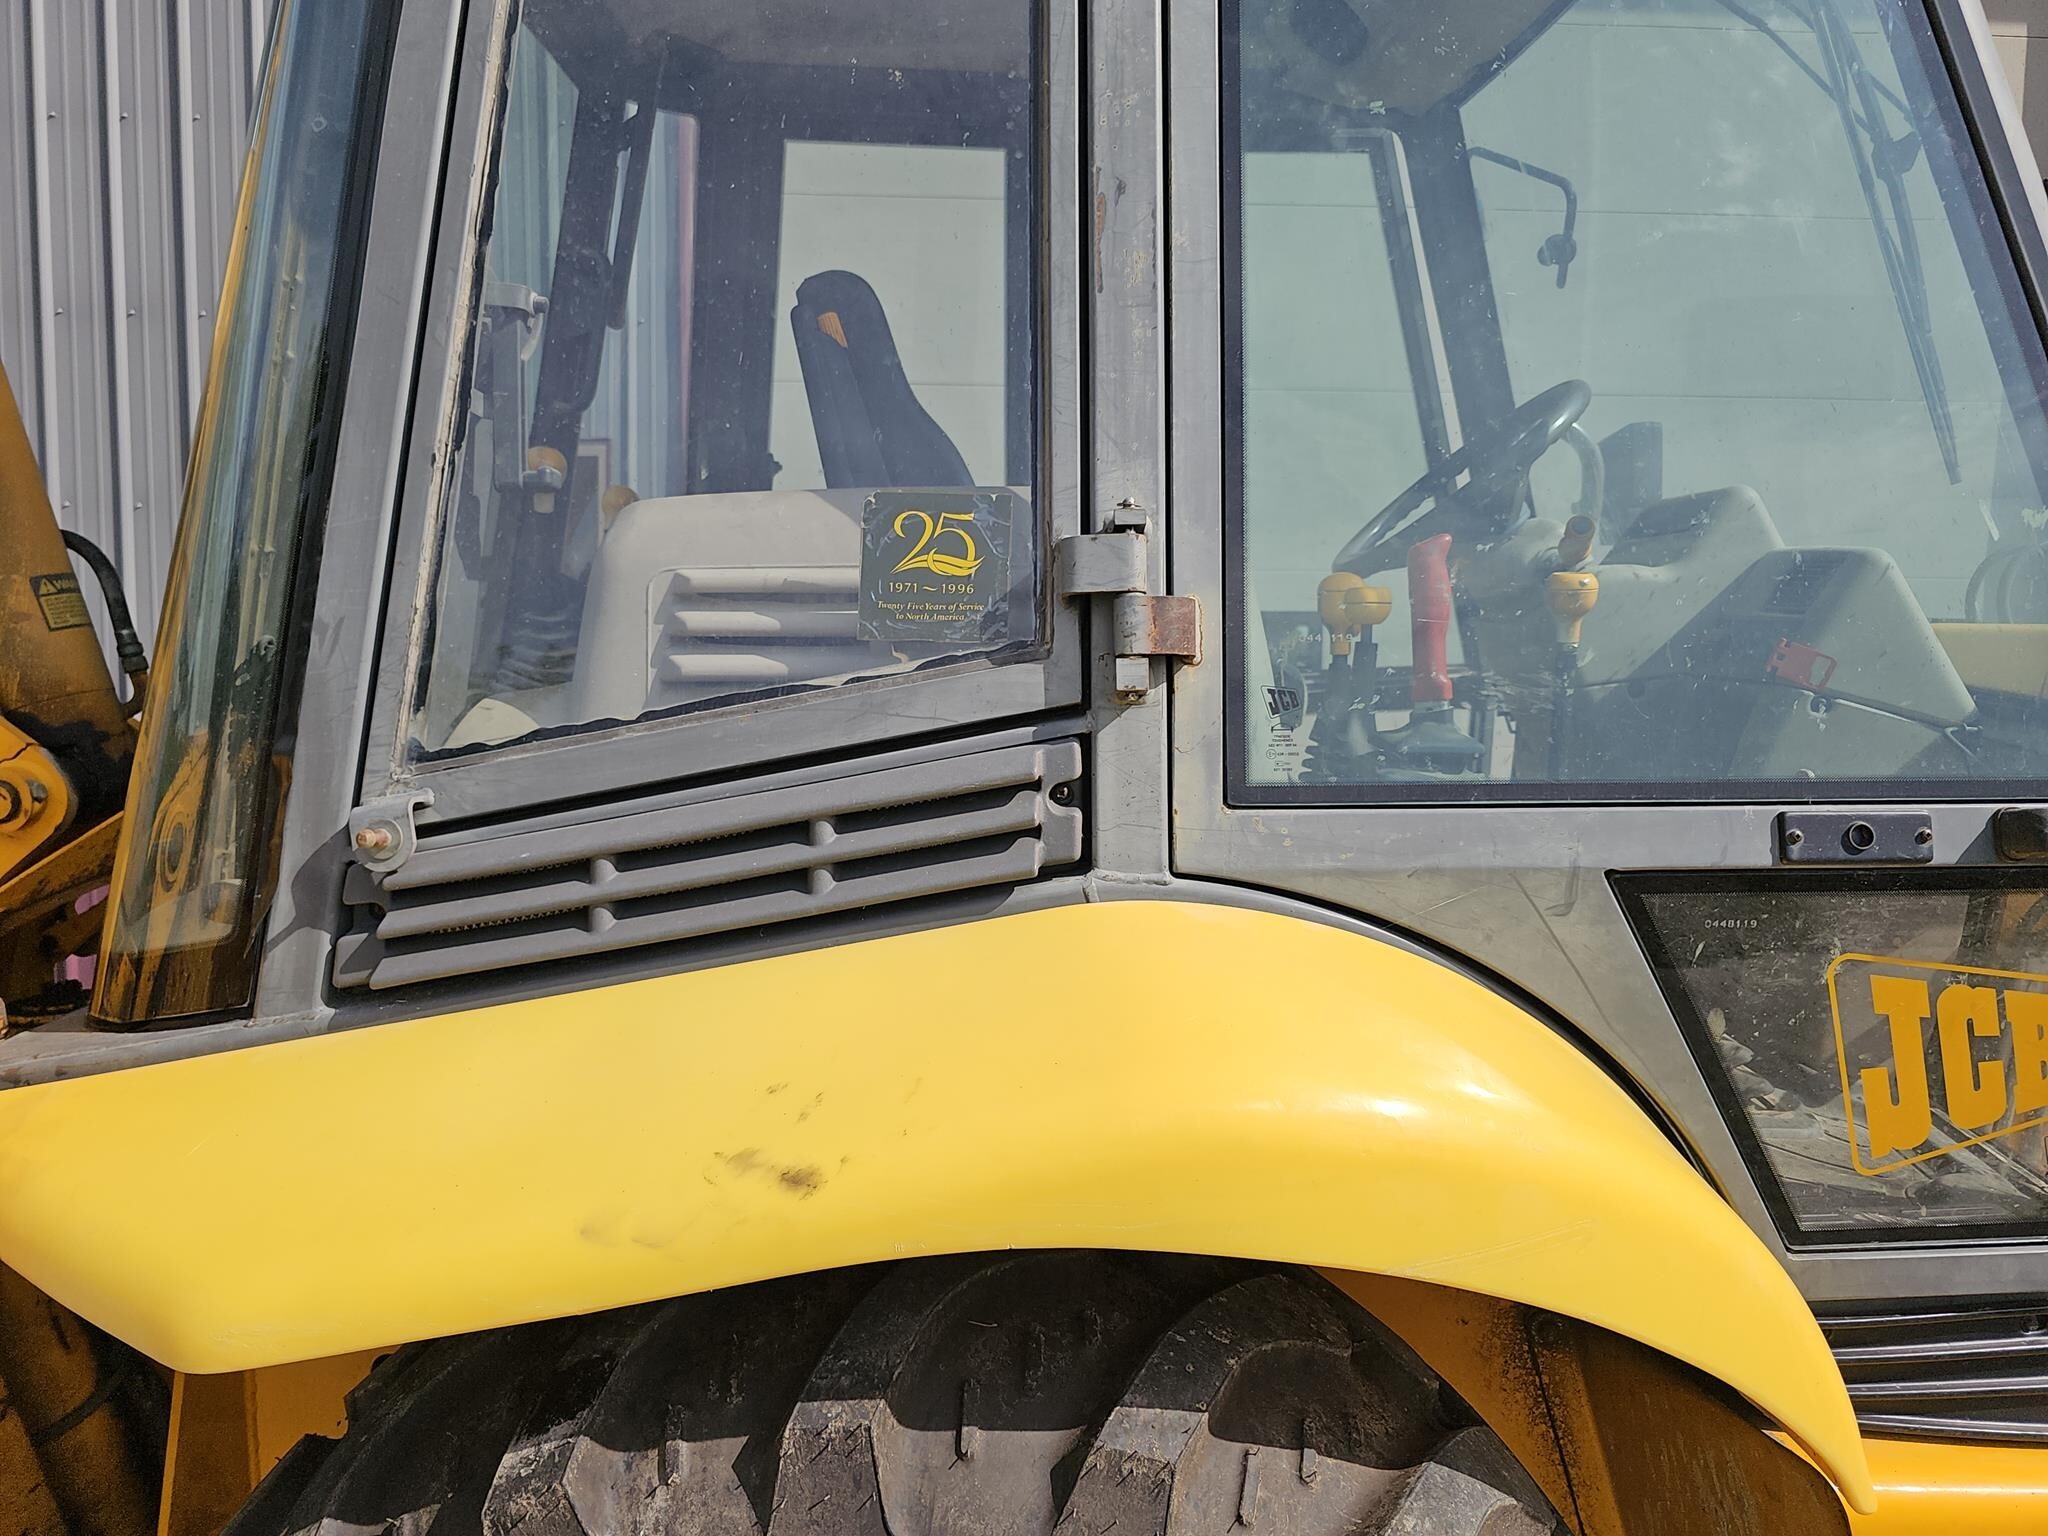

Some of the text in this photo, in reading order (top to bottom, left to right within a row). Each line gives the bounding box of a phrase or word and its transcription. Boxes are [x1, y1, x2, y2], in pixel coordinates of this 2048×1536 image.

[889, 510, 985, 577] 25
[889, 582, 918, 594] 1971
[941, 583, 975, 594] 1996
[877, 600, 985, 613] Twenty Five Years of Service
[895, 612, 965, 621] to North America
[1266, 688, 1300, 716] JCB
[1860, 974, 2048, 1159] JCB
